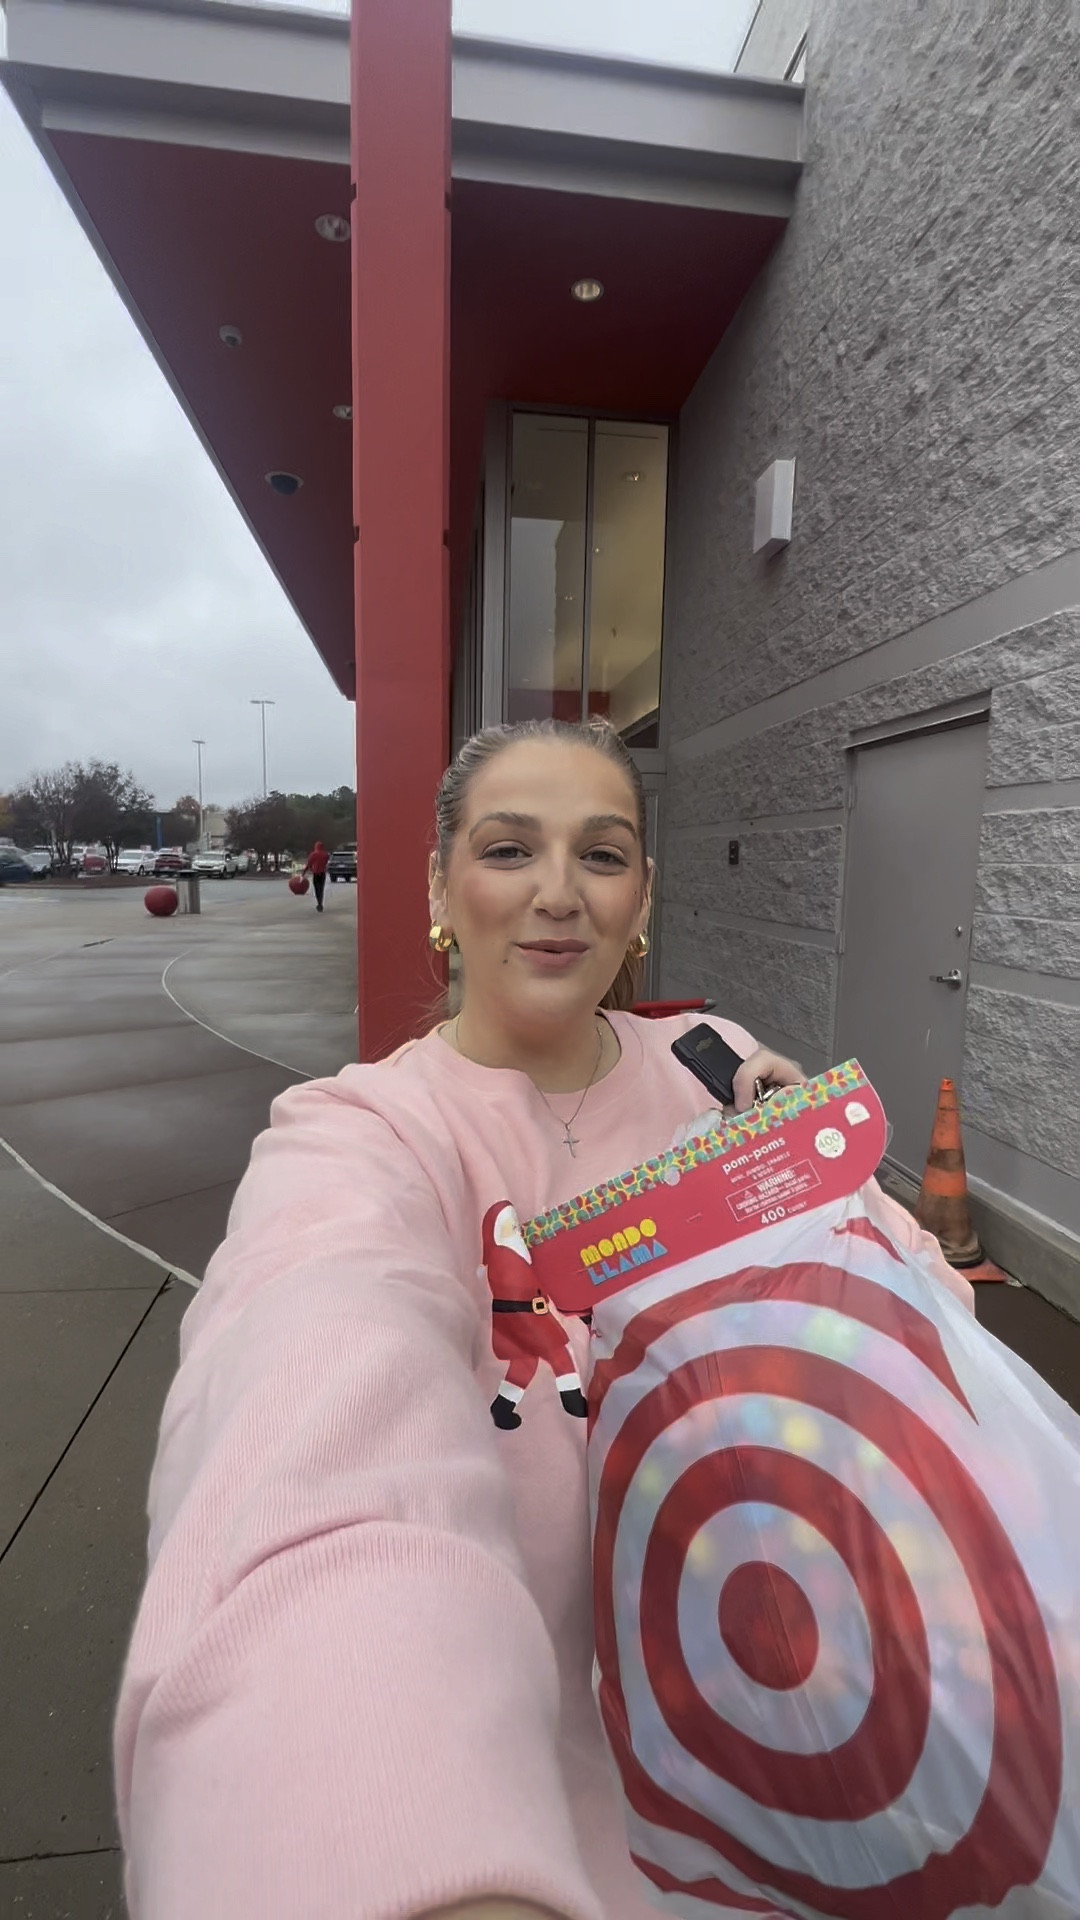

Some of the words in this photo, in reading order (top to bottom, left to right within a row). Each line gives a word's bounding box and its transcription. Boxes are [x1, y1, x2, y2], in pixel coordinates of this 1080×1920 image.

[722, 1137, 786, 1175] pom-poms
[818, 1131, 841, 1148] 400
[761, 1206, 786, 1225] 400
[580, 1218, 657, 1267] MONDO
[587, 1239, 668, 1286] LLAMA
